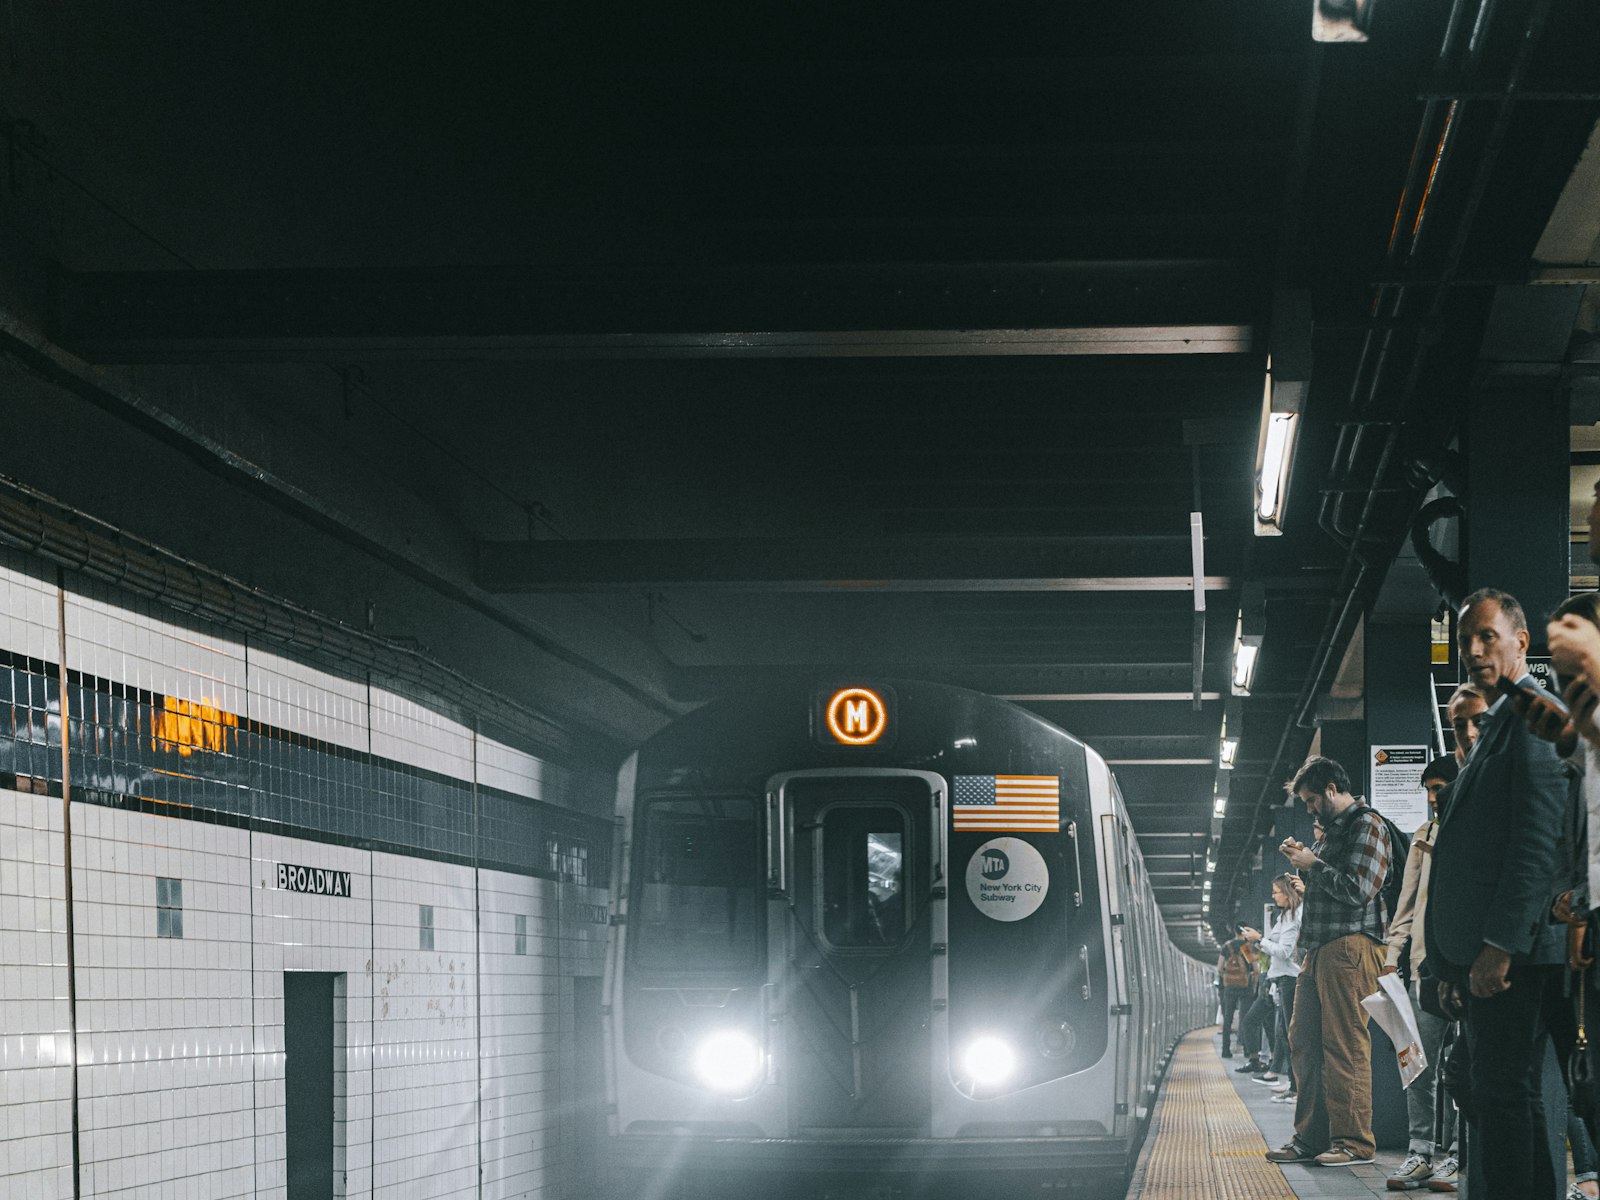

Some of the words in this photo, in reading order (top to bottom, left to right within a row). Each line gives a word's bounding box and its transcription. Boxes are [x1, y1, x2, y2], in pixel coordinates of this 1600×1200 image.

[846, 700, 867, 731] M
[981, 855, 1005, 873] MTA
[278, 864, 351, 897] BROADWAY
[980, 883, 1000, 891] New
[1002, 883, 1022, 891] York
[1024, 883, 1042, 893] City
[981, 893, 1016, 902] Subway
